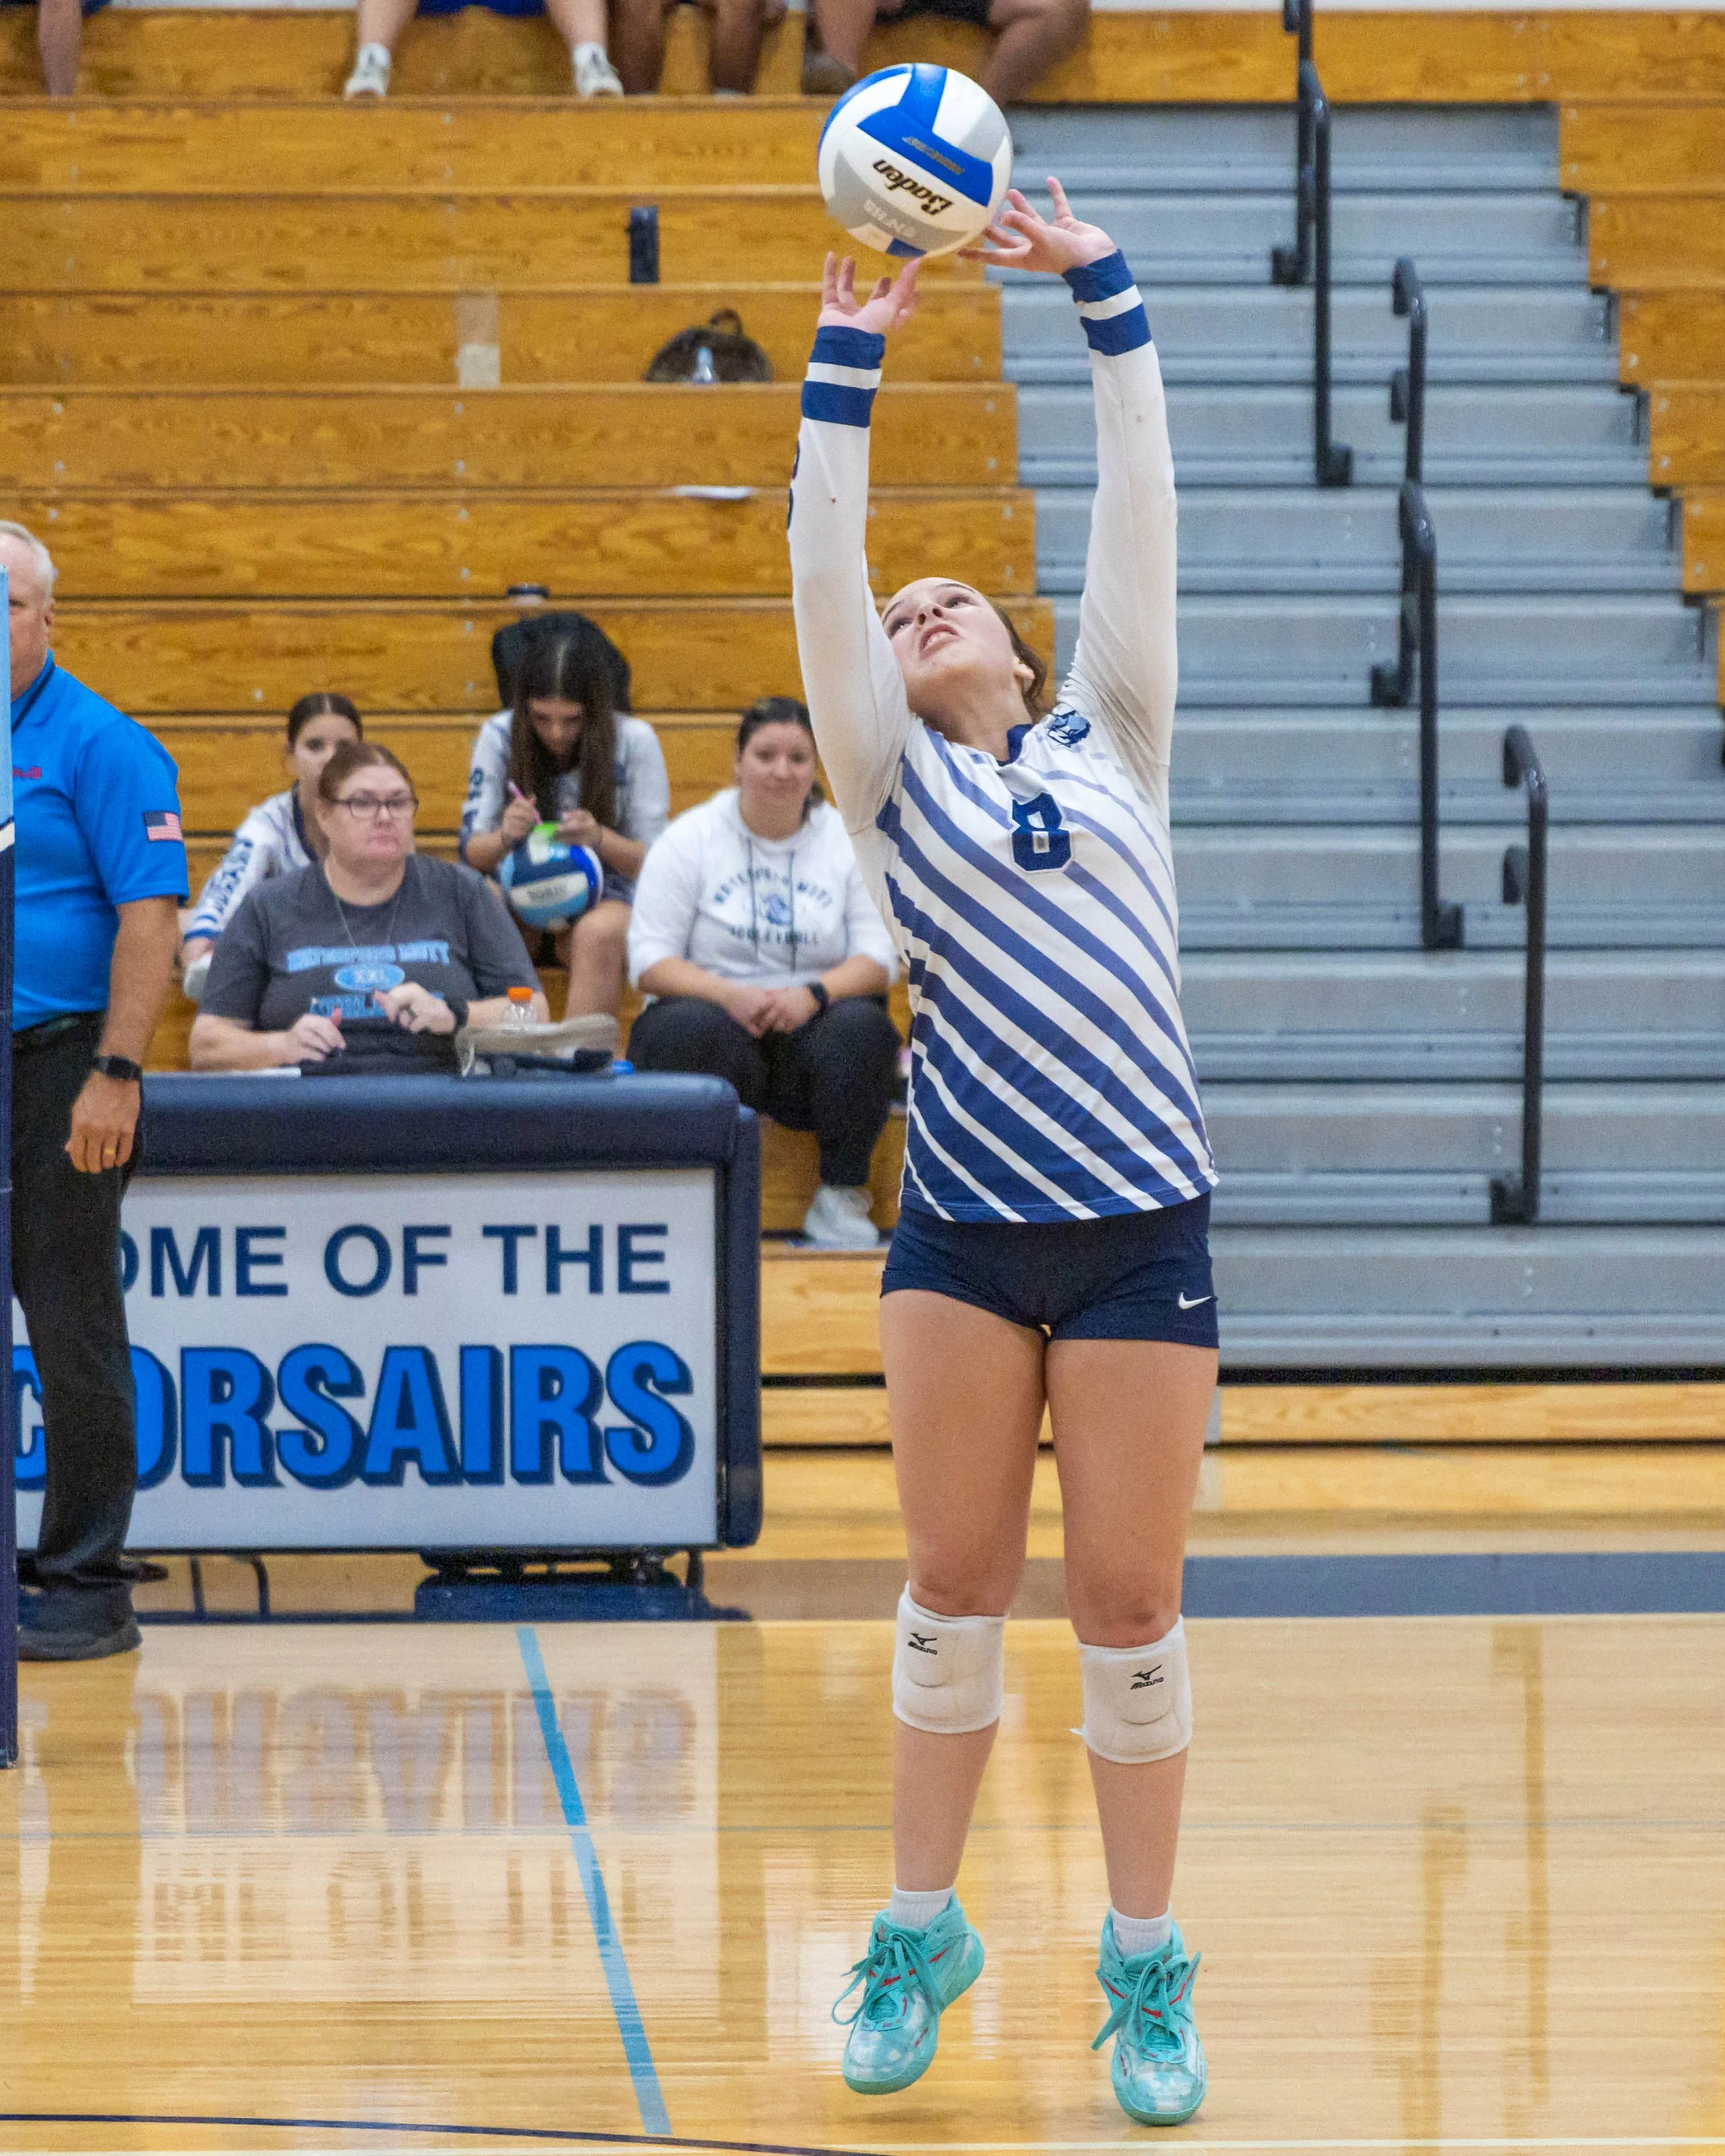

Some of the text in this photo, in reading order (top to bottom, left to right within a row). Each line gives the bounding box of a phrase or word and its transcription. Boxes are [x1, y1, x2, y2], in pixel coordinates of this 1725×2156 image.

[872, 159, 954, 215] Baden
[1011, 792, 1071, 871] 8
[119, 1224, 671, 1298] ME OF THE
